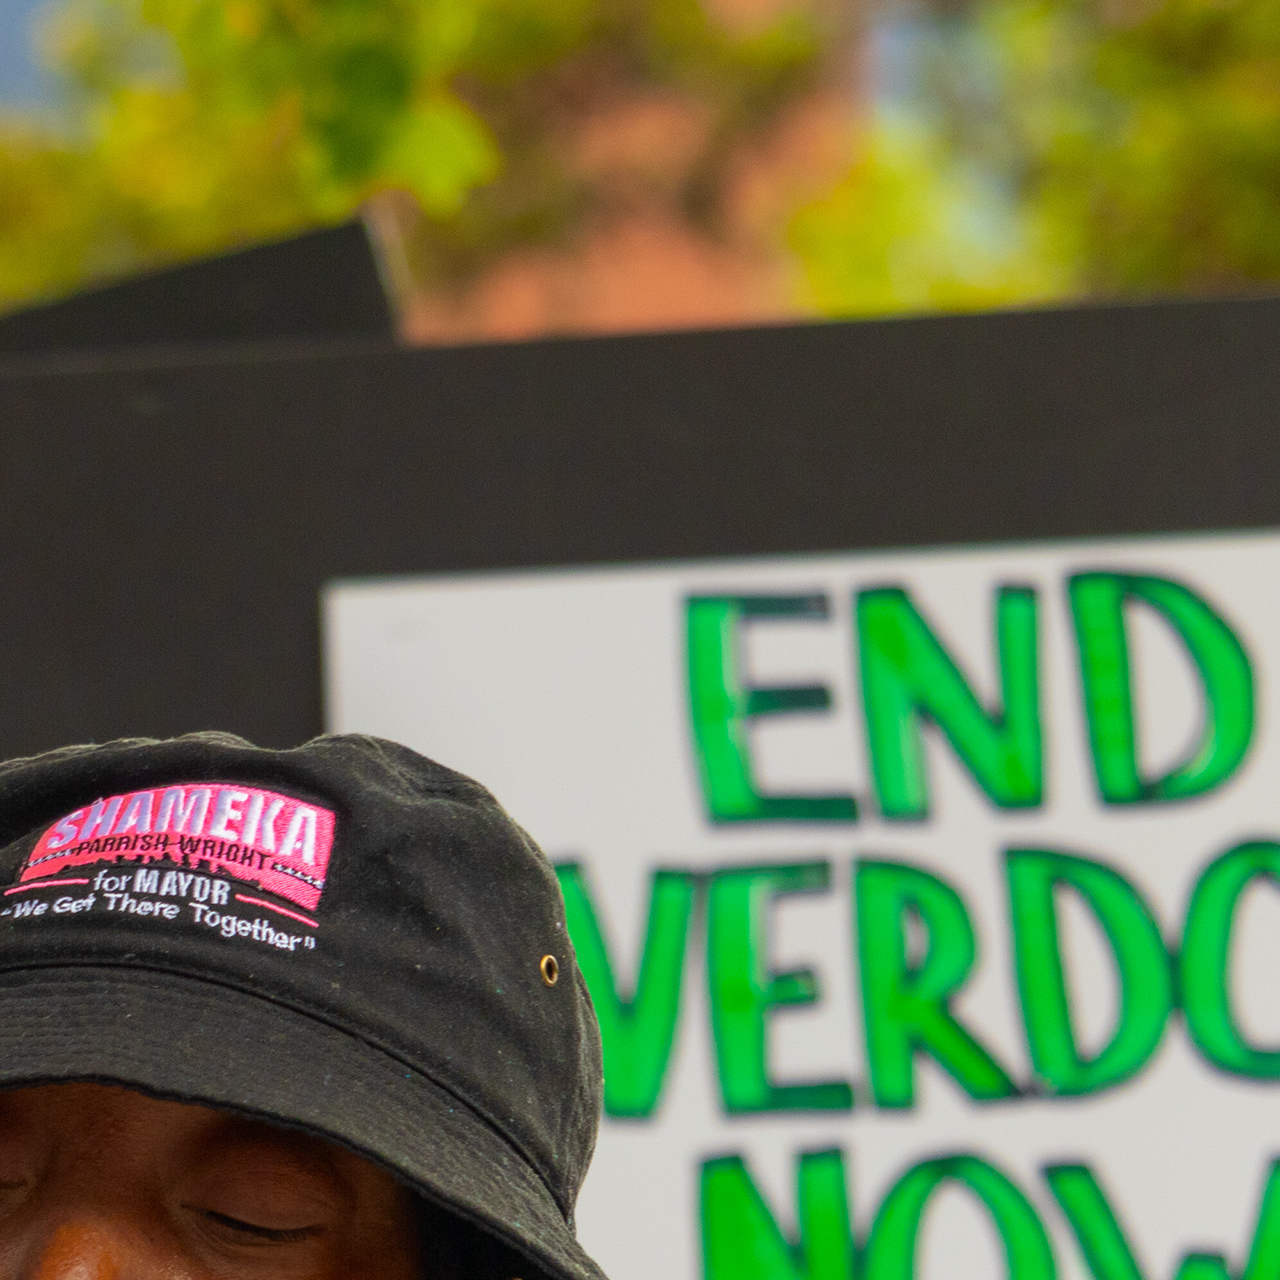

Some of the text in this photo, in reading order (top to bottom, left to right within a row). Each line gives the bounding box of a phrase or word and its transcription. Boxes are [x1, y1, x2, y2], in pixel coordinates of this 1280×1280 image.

[682, 568, 1260, 828] END
[47, 788, 317, 866] SHAMEKA
[52, 893, 96, 913] Get
[103, 893, 181, 919] There
[93, 868, 231, 905] for MAYOR
